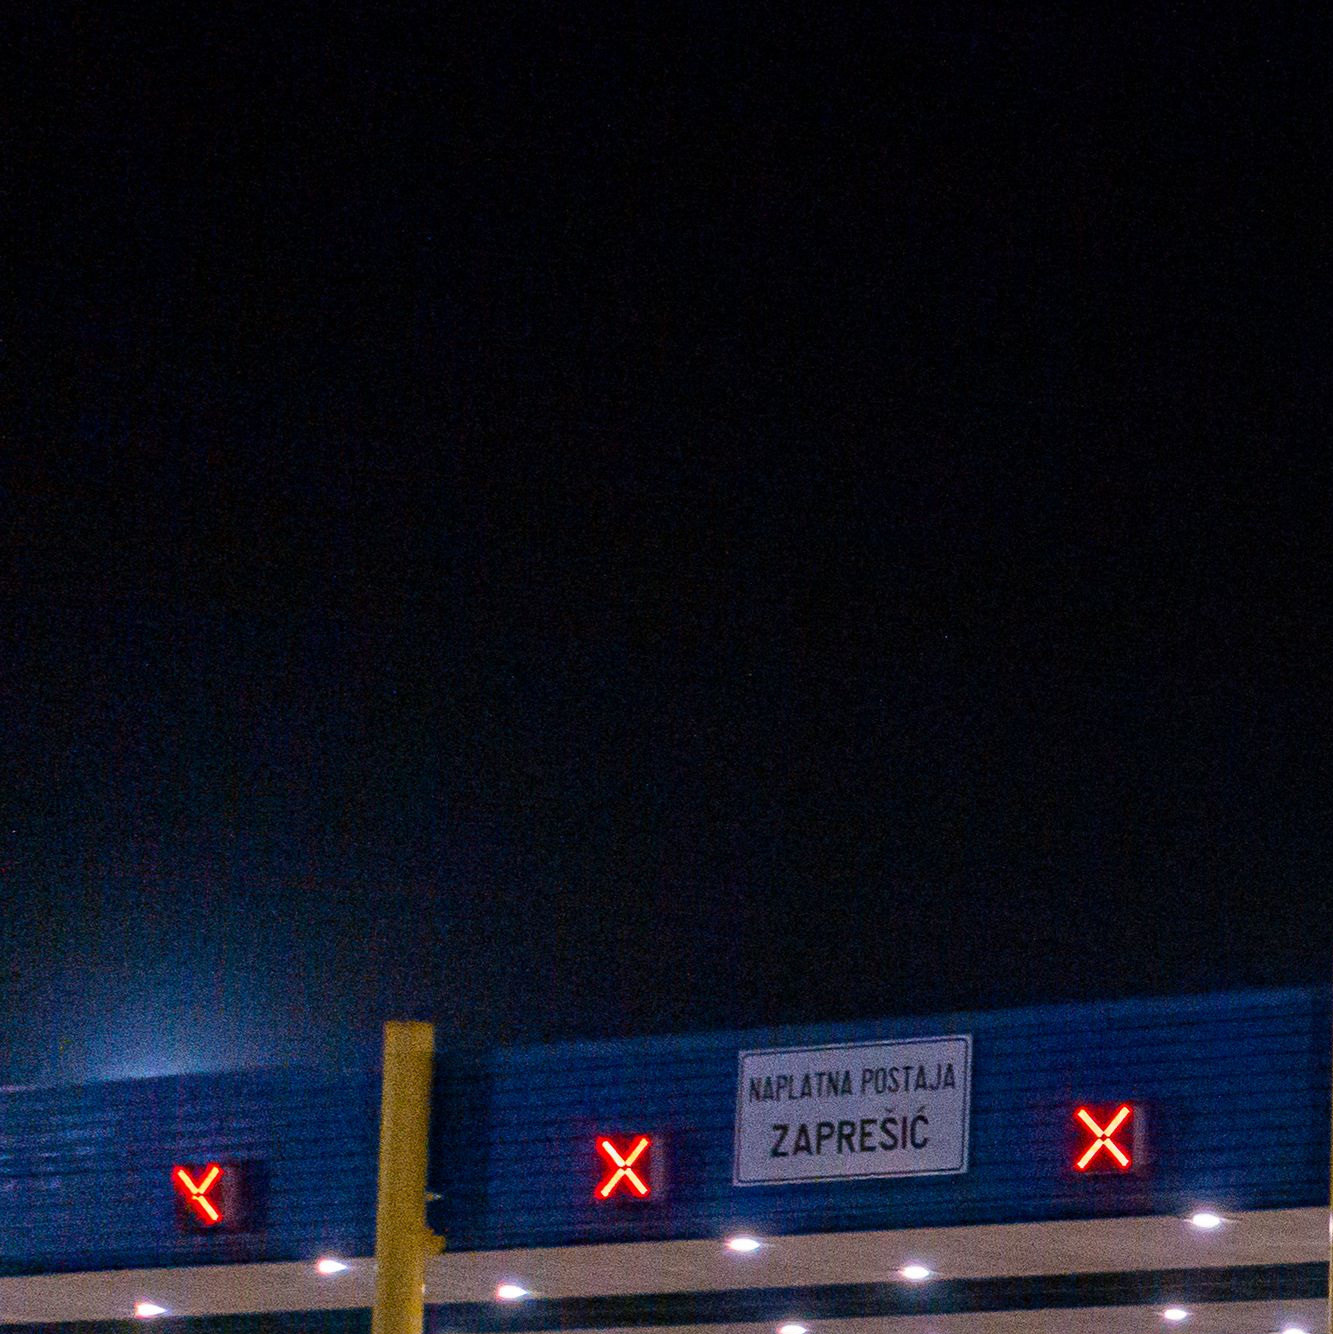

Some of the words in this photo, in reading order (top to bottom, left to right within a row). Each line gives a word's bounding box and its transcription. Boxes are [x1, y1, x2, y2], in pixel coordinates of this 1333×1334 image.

[749, 1070, 854, 1102] NAPLATNA
[861, 1063, 955, 1095] POSTAJA
[770, 1106, 929, 1158] ZAPREŠIĆ
